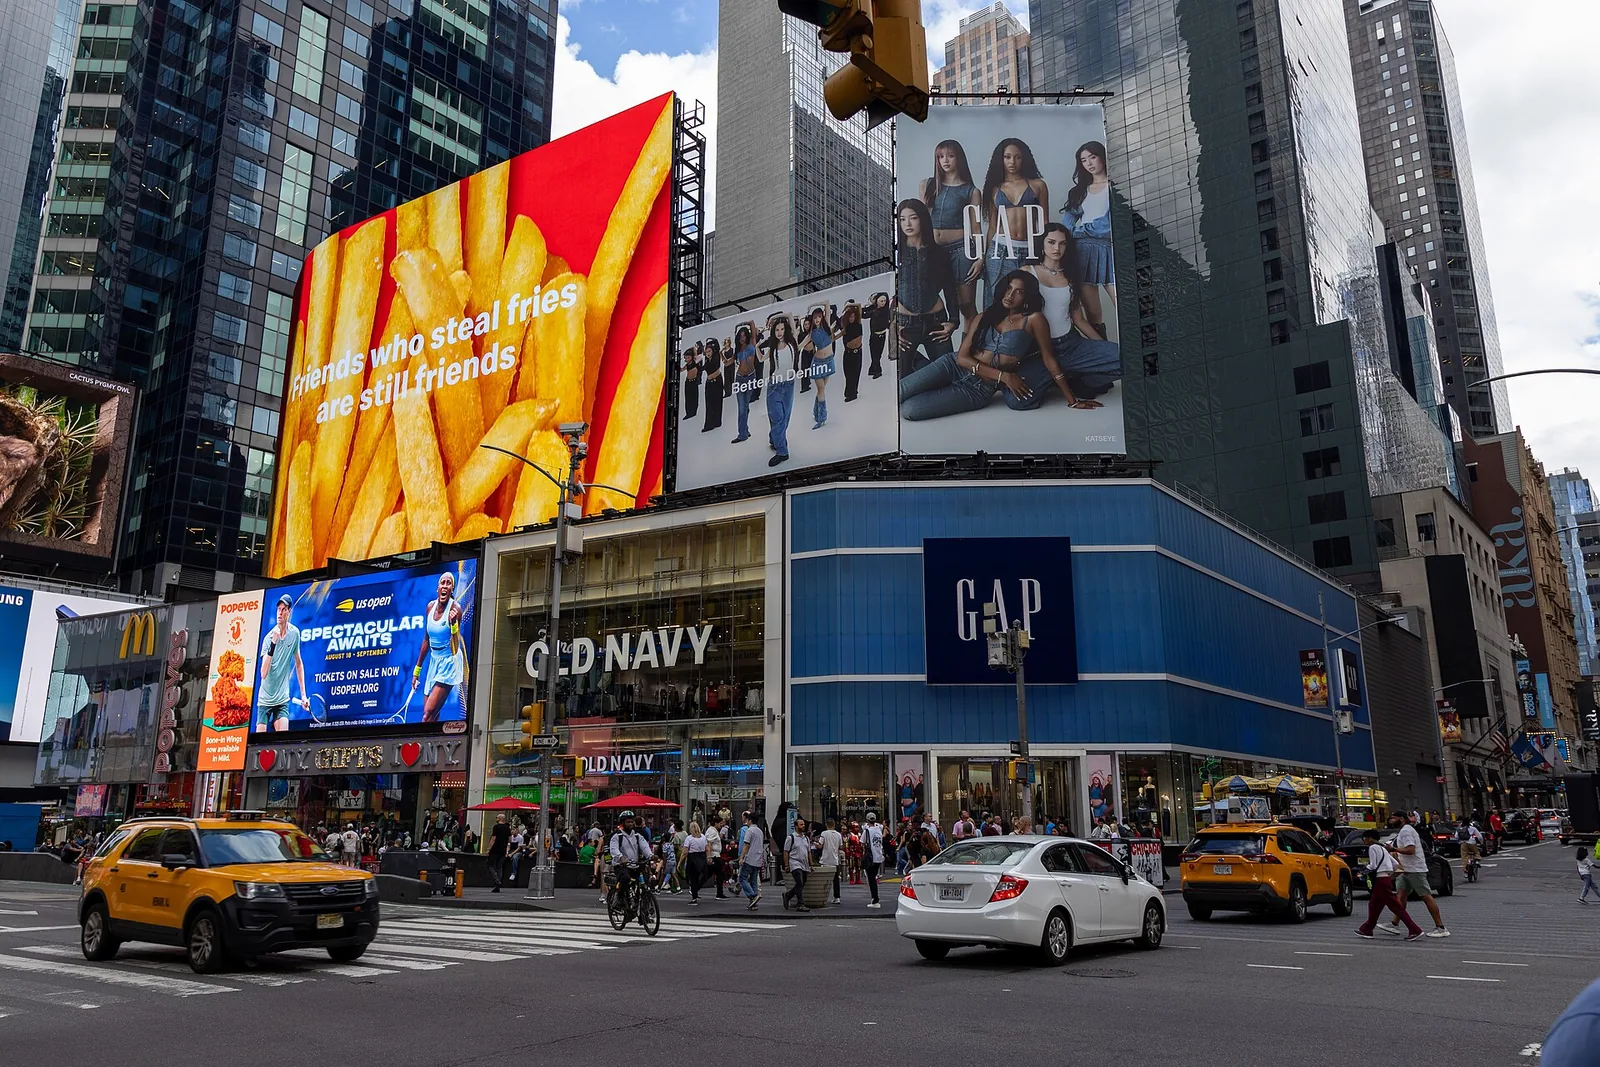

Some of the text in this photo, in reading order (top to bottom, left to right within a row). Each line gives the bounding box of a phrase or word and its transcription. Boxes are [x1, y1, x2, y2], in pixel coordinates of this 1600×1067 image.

[962, 204, 1045, 261] GAP
[292, 282, 578, 402] Friends who steal fries
[69, 372, 131, 394] CACTUS PYGMY OWL
[316, 344, 516, 425] are still friends
[731, 362, 833, 395] Better in Denim.
[1084, 435, 1117, 443] KATSEYE
[956, 578, 1042, 642] GAP
[300, 615, 424, 642] SPECTACULAR
[326, 632, 393, 652] AWAITS
[604, 624, 714, 672] NAVY
[325, 652, 345, 661] AUGUST
[356, 649, 387, 658] SEPTEMBER
[315, 666, 400, 683] TICKETS ON SALE NOW
[330, 682, 379, 696] USOPEN.ORG
[314, 745, 384, 770] GIFTS
[610, 753, 654, 772] NAVY
[1131, 843, 1161, 856] CHICAGO
